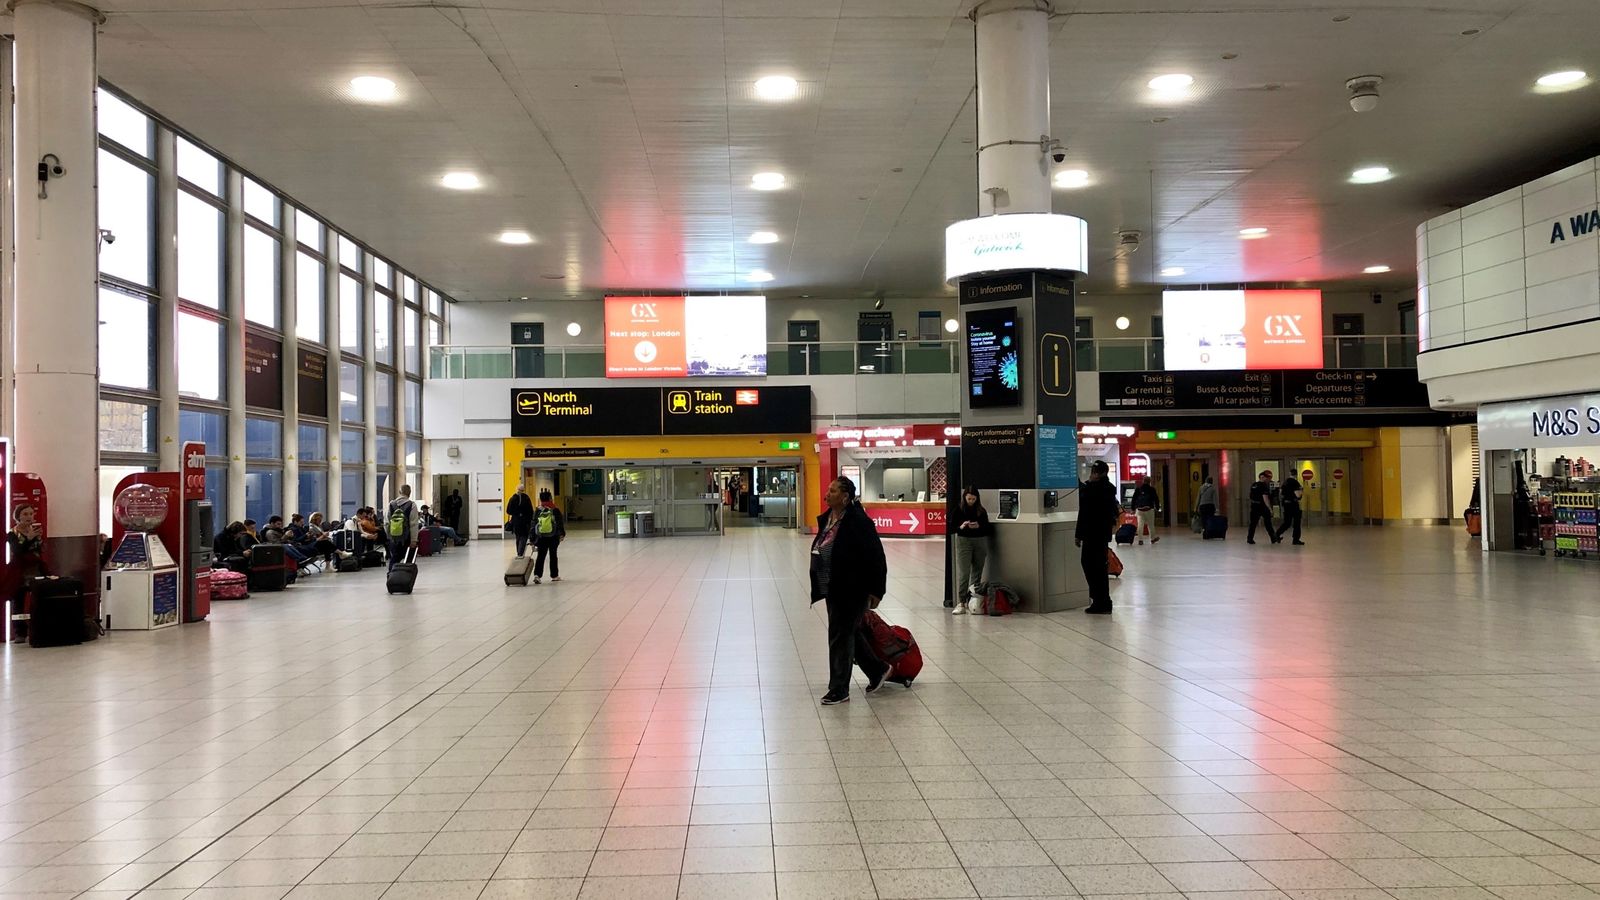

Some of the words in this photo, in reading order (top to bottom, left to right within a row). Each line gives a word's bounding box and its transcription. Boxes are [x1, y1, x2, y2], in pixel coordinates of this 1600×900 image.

[1550, 222, 1565, 244] A
[980, 283, 1023, 295] Information
[631, 303, 657, 317] GX
[1264, 315, 1303, 336] GX
[630, 330, 649, 338] stop:
[1142, 375, 1162, 383] Taxis
[1245, 373, 1259, 381] Exit
[1315, 371, 1352, 380] Check-in
[1125, 386, 1138, 394] Car
[1140, 386, 1163, 394] rental
[1196, 385, 1219, 393] Buses
[1220, 385, 1227, 393] &
[1228, 385, 1260, 393] coaches
[1306, 384, 1352, 394] Departures
[543, 391, 577, 402] North
[694, 390, 722, 401] Train
[1294, 395, 1325, 404] Service
[1326, 396, 1352, 404] centre
[1138, 397, 1164, 406] Hotels
[1214, 396, 1224, 404] All
[1239, 396, 1260, 406] parks
[543, 404, 592, 415] Terminal
[695, 403, 733, 414] station
[1532, 408, 1580, 437] M&S
[827, 430, 863, 440] currency
[864, 427, 905, 439] exchange
[964, 430, 983, 438] Airport
[187, 450, 206, 468] atm
[927, 511, 942, 520] 0%
[872, 516, 893, 527] atm
